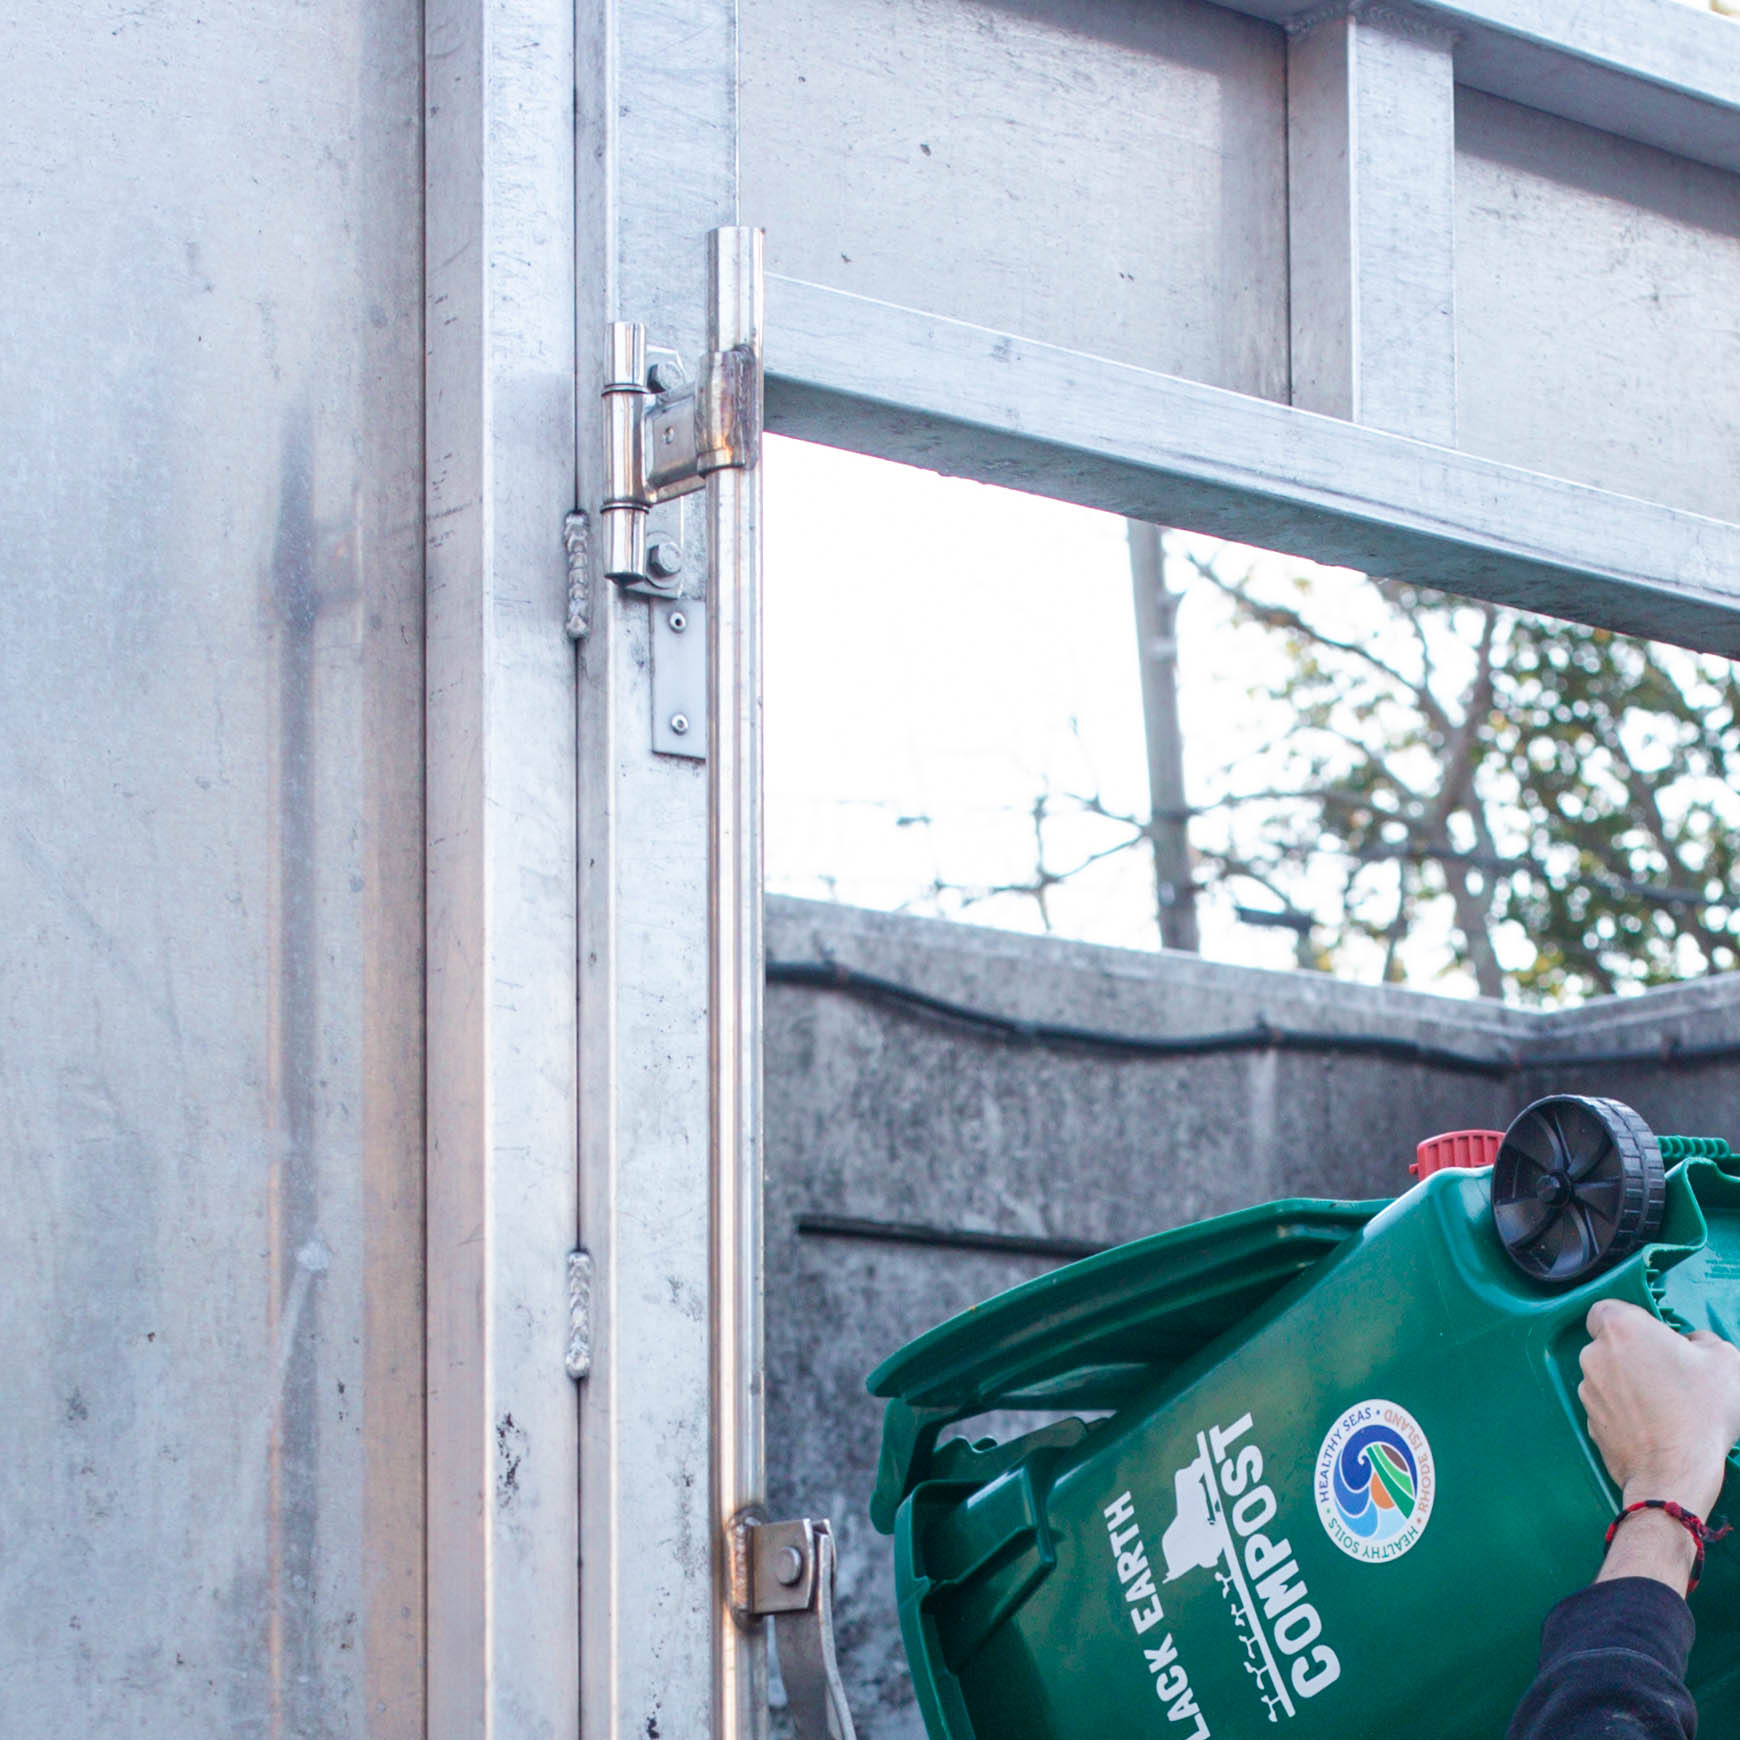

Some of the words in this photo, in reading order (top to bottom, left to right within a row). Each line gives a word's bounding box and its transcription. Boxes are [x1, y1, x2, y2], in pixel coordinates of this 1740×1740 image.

[1319, 1428, 1343, 1503] HEALTHY
[1342, 1407, 1372, 1432] SEAS
[1384, 1409, 1424, 1450] ISLAND
[1418, 1453, 1431, 1512] RHODE
[1103, 1491, 1165, 1635] EARTH
[1209, 1411, 1341, 1698] COMPOST
[1328, 1517, 1359, 1553] SOILS
[1362, 1525, 1418, 1559] HEALTHY
